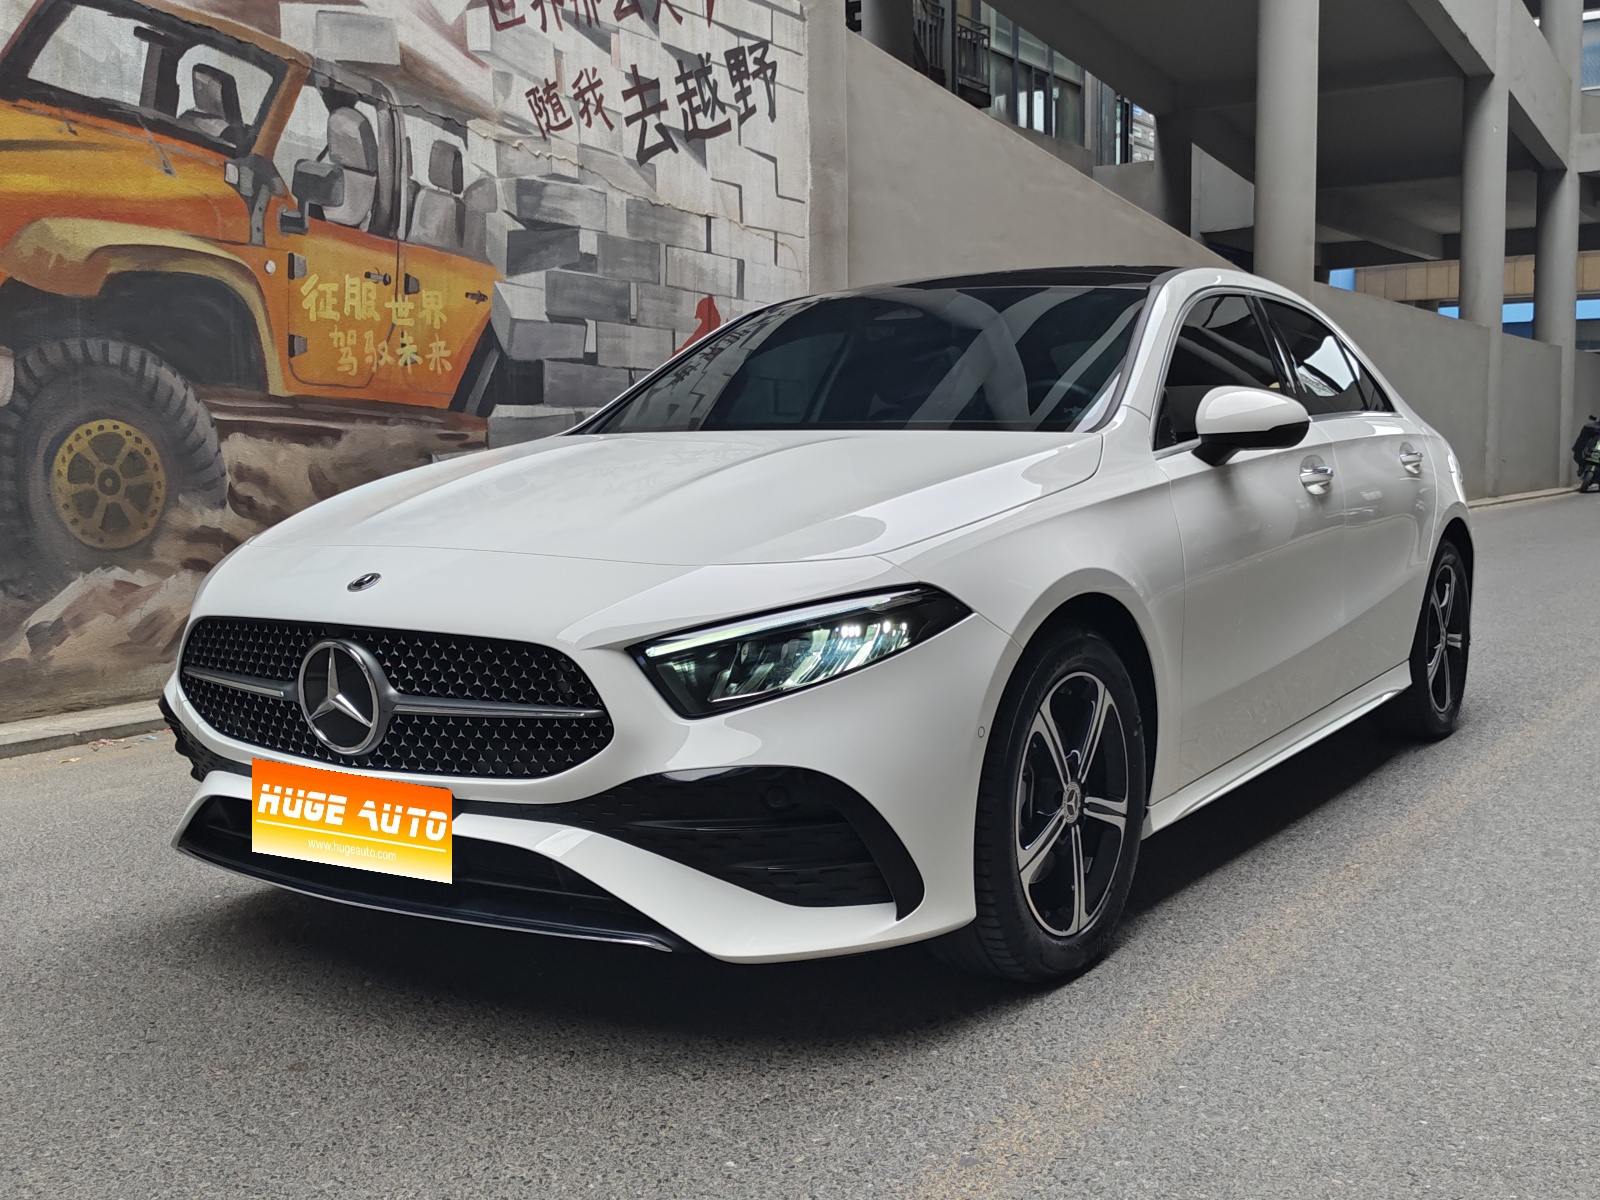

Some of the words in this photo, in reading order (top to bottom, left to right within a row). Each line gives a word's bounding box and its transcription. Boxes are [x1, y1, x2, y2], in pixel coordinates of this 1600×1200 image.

[525, 40, 777, 166] 随我去越野
[301, 274, 447, 329] 征服世界
[329, 325, 452, 376] 驾驭未来
